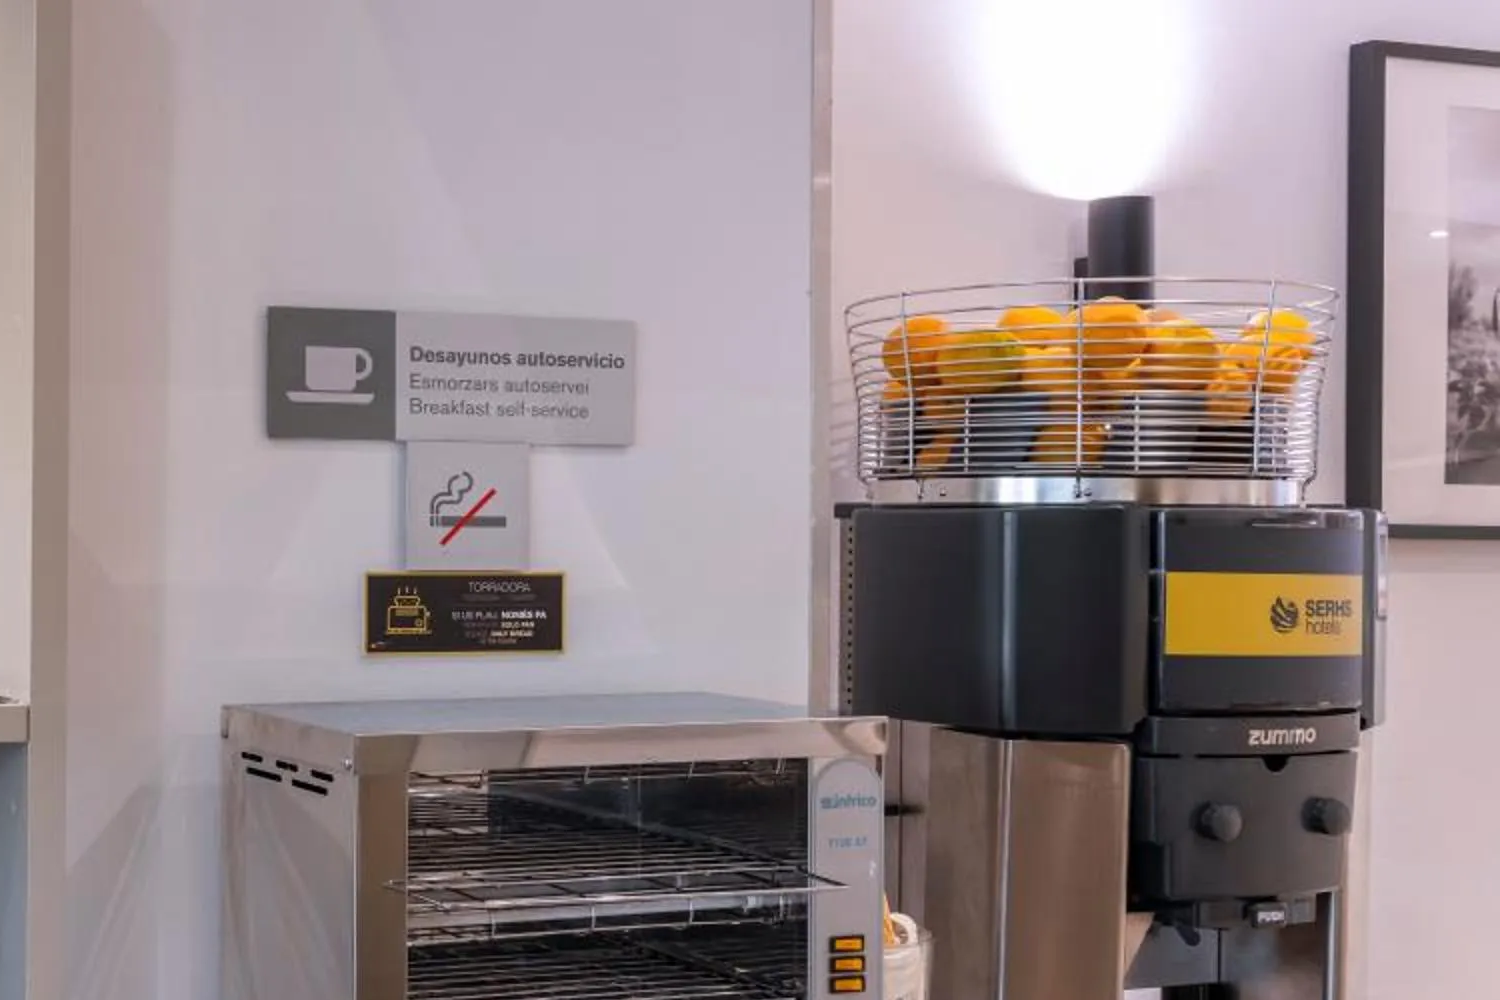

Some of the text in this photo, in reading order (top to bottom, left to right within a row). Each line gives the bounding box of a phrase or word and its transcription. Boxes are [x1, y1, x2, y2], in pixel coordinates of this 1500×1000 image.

[409, 346, 625, 369] Desayunos autoservicio
[409, 373, 589, 395] Esmorzars autoservei
[409, 398, 589, 419] Breakfast self-service
[1305, 600, 1352, 617] SERHS
[1305, 618, 1342, 635] hotels
[1248, 727, 1317, 745] zummo
